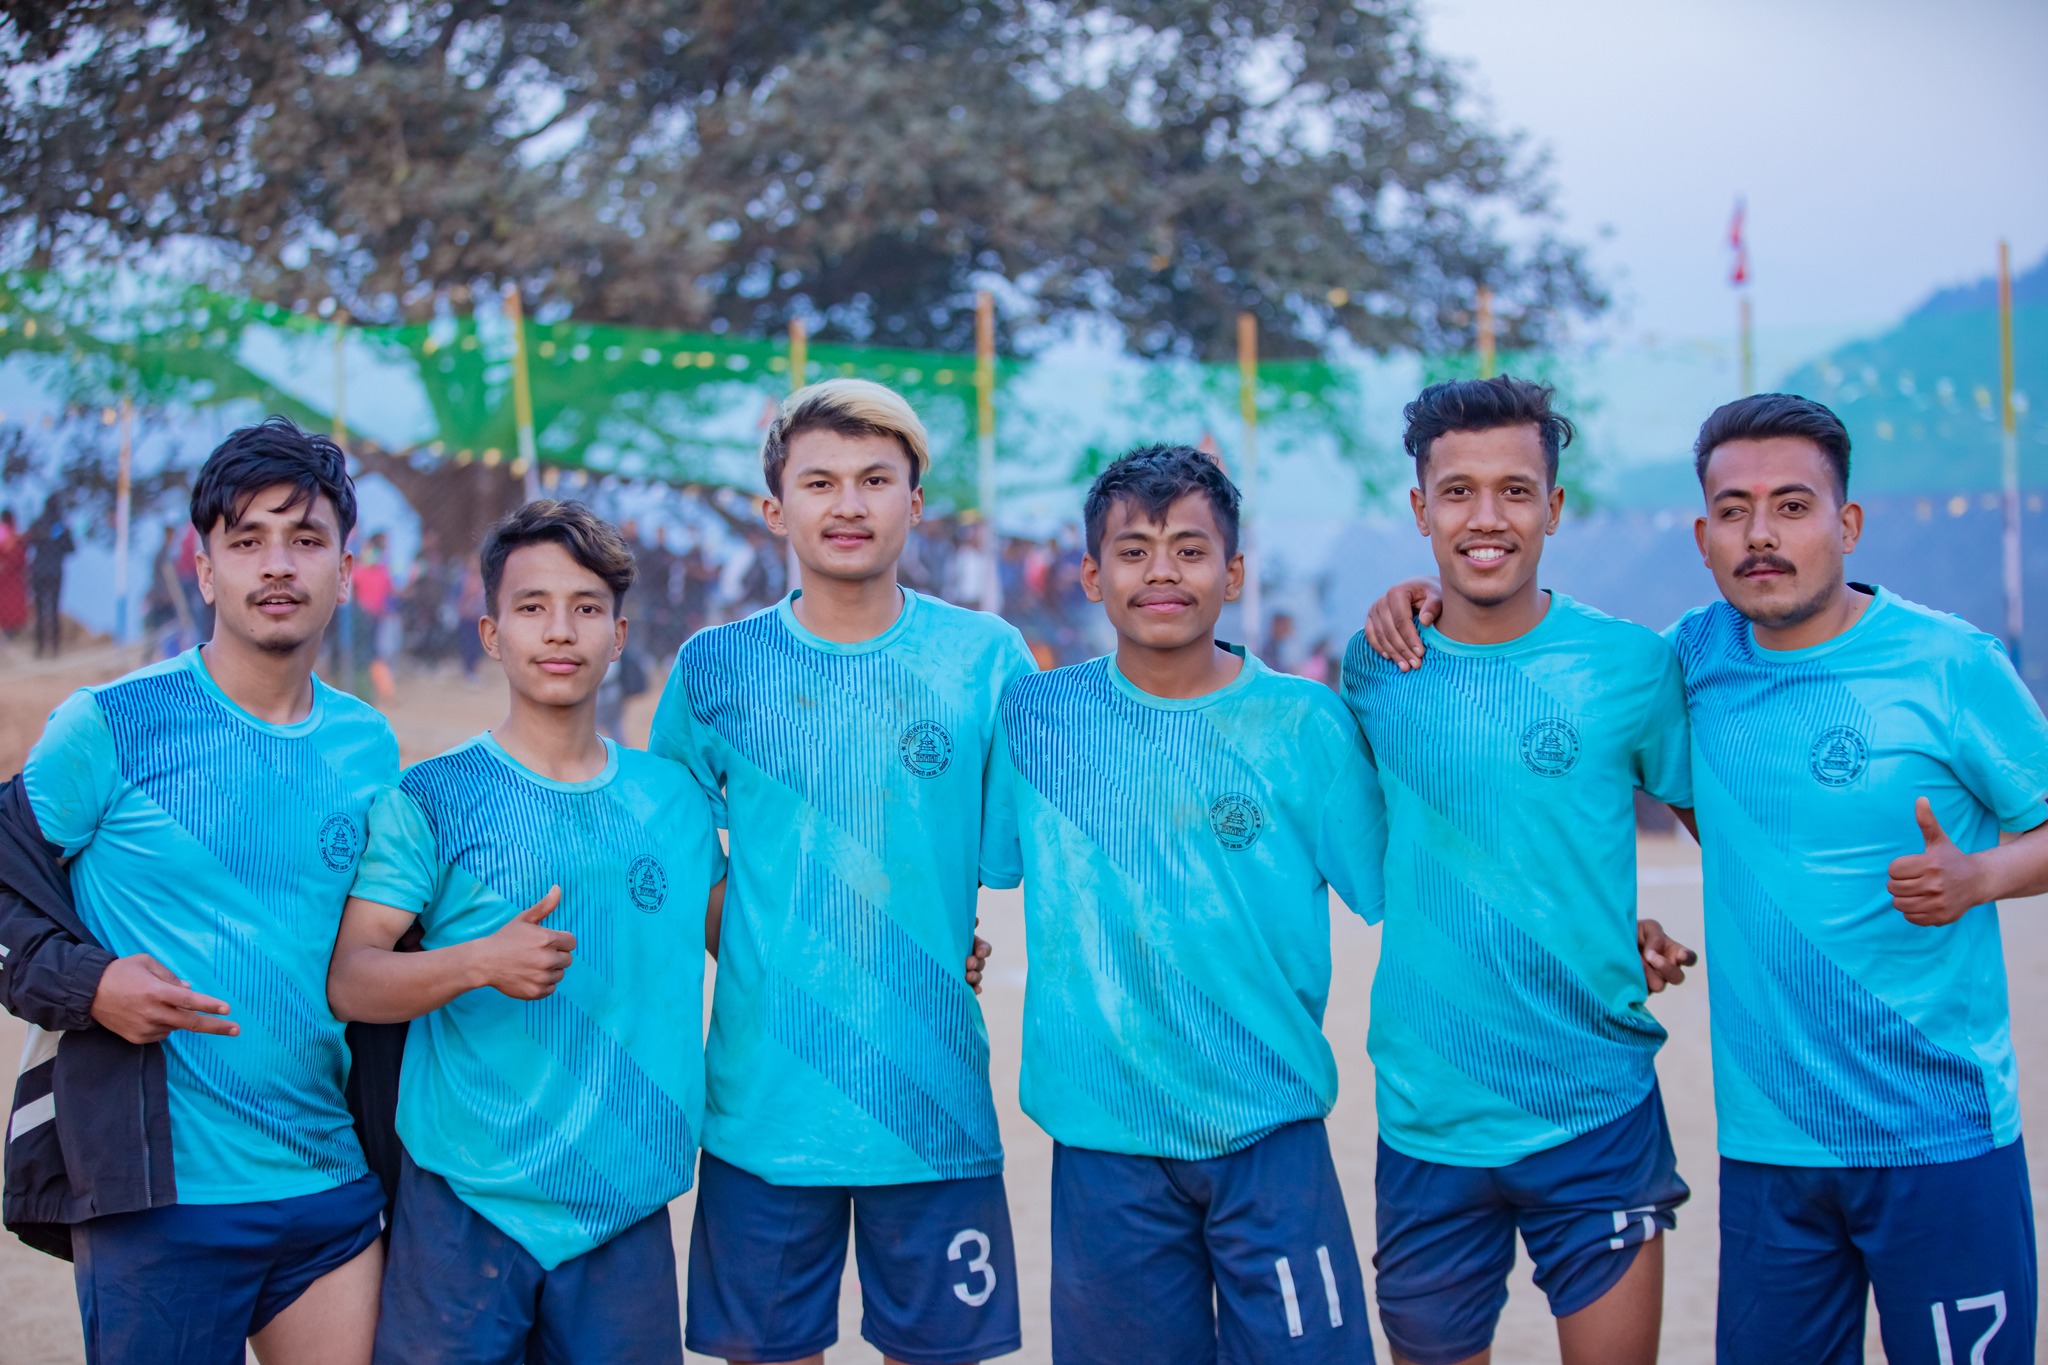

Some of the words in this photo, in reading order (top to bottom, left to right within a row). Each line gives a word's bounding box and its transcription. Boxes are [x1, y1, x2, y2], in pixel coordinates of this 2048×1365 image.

[947, 1228, 996, 1307] 3
[1275, 1245, 1343, 1338] 11
[1931, 1290, 2008, 1365] 17
